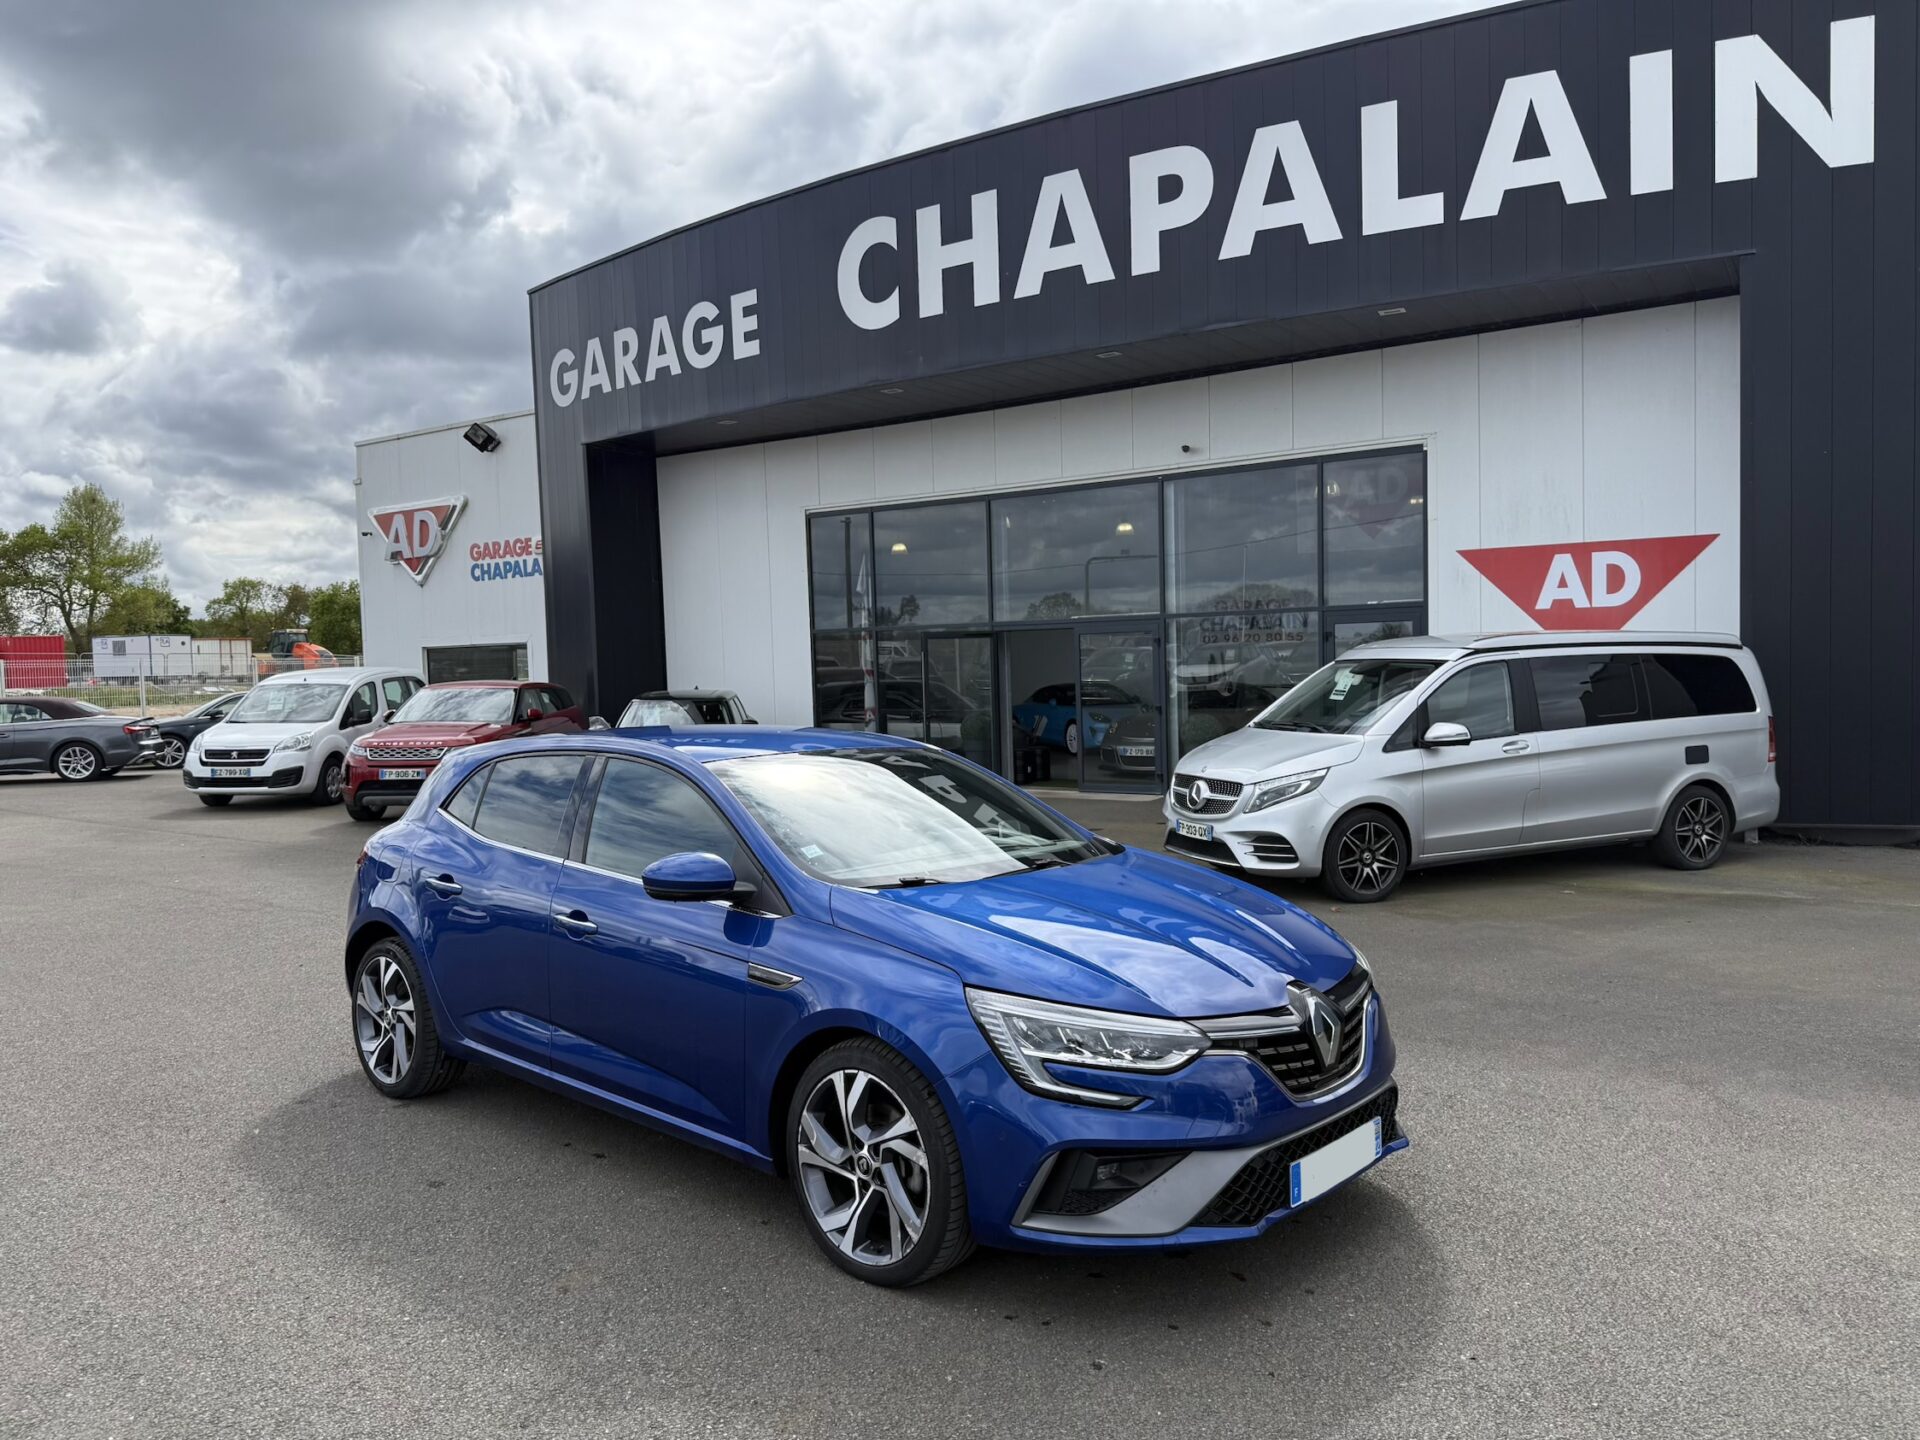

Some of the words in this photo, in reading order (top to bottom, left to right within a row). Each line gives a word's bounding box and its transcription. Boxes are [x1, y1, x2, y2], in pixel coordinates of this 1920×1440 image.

[549, 288, 761, 408] GARAGE
[837, 15, 1876, 331] CHAPALAIN
[386, 510, 439, 560] AD
[470, 537, 533, 562] GARAGE
[1535, 551, 1642, 610] AD
[1202, 634, 1218, 643] 02
[1223, 633, 1240, 643] 96
[1244, 633, 1261, 642] 20
[1266, 632, 1282, 641] 80
[1287, 632, 1304, 641] 55
